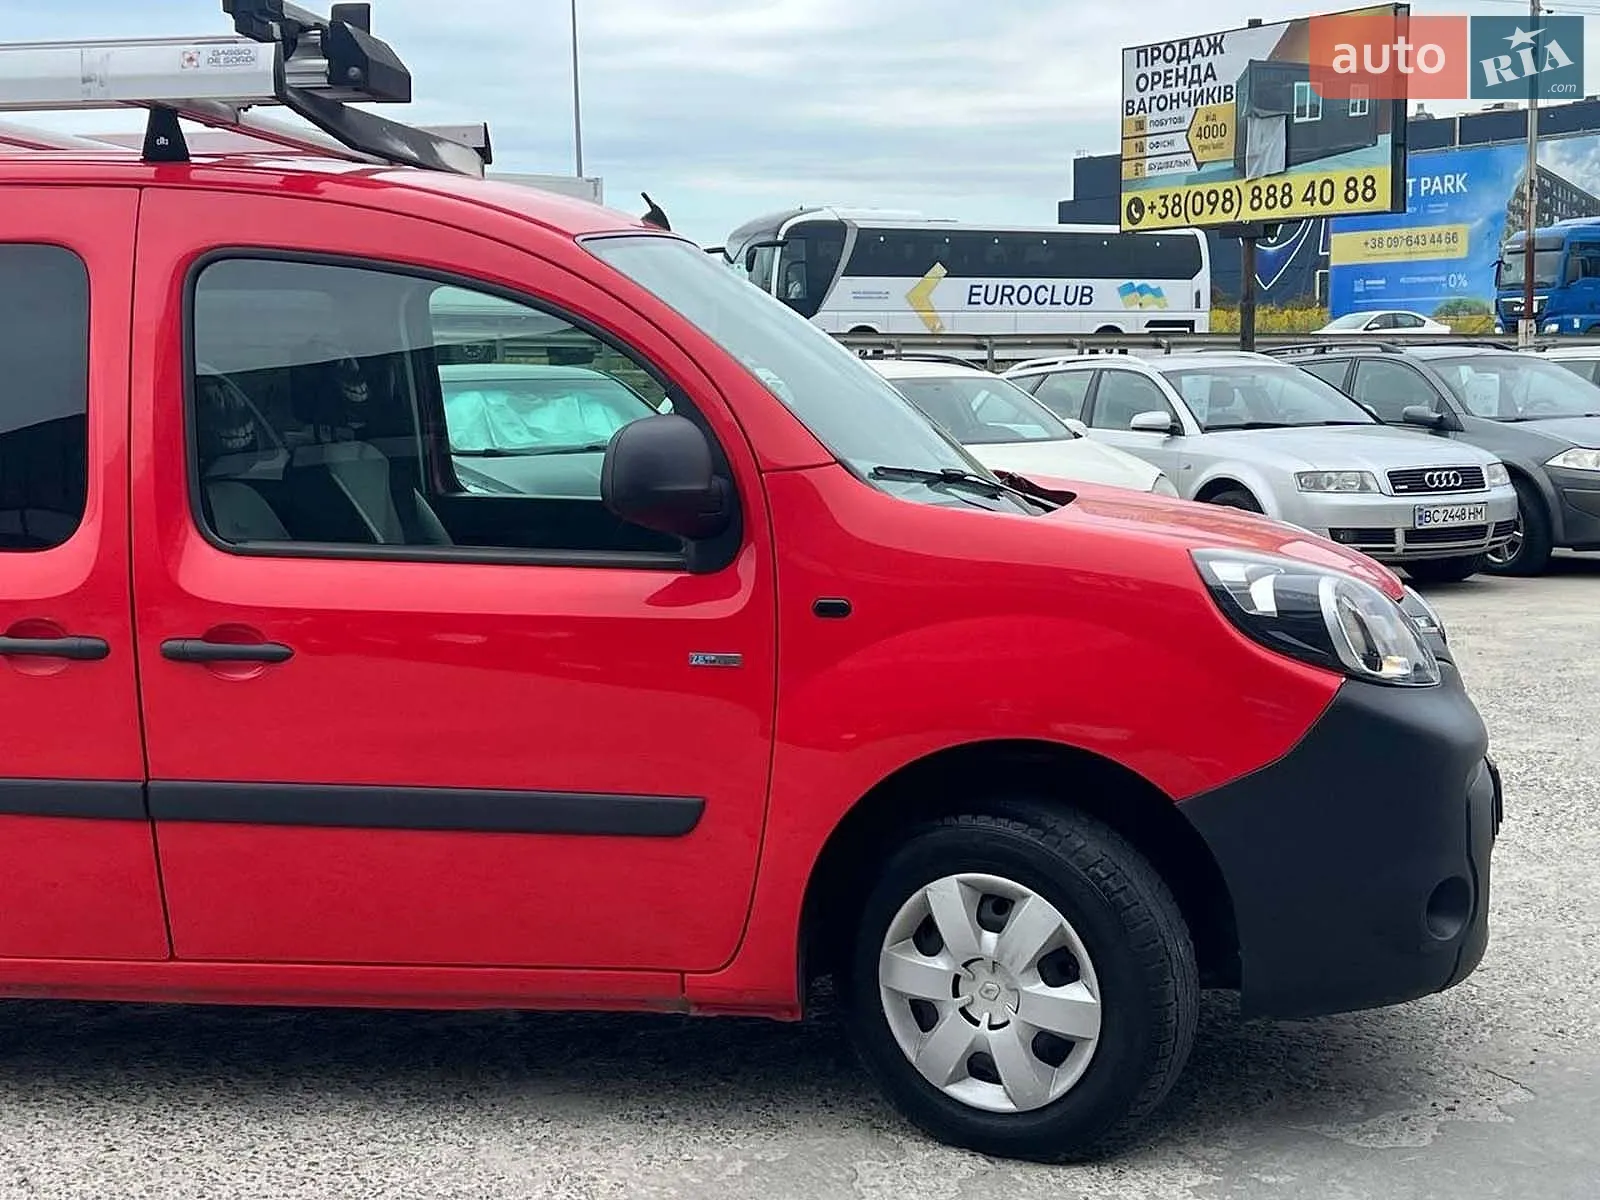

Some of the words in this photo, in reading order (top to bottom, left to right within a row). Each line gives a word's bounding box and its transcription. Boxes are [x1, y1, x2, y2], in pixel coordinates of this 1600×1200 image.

[1136, 35, 1225, 68] ПРОДАЖ
[1136, 62, 1217, 92] ОРЕНДА
[1125, 85, 1234, 116] ВАГОНЧИКІВ
[1196, 123, 1227, 140] 4000
[1420, 172, 1468, 196] PARK
[1148, 185, 1242, 223] +38(098)
[1250, 182, 1293, 211] 888
[1301, 178, 1335, 206] 40
[1344, 175, 1377, 203] 88
[967, 284, 1094, 306] EUROCLUB
[1424, 510, 1440, 523] BC
[1442, 507, 1466, 522] 2448
